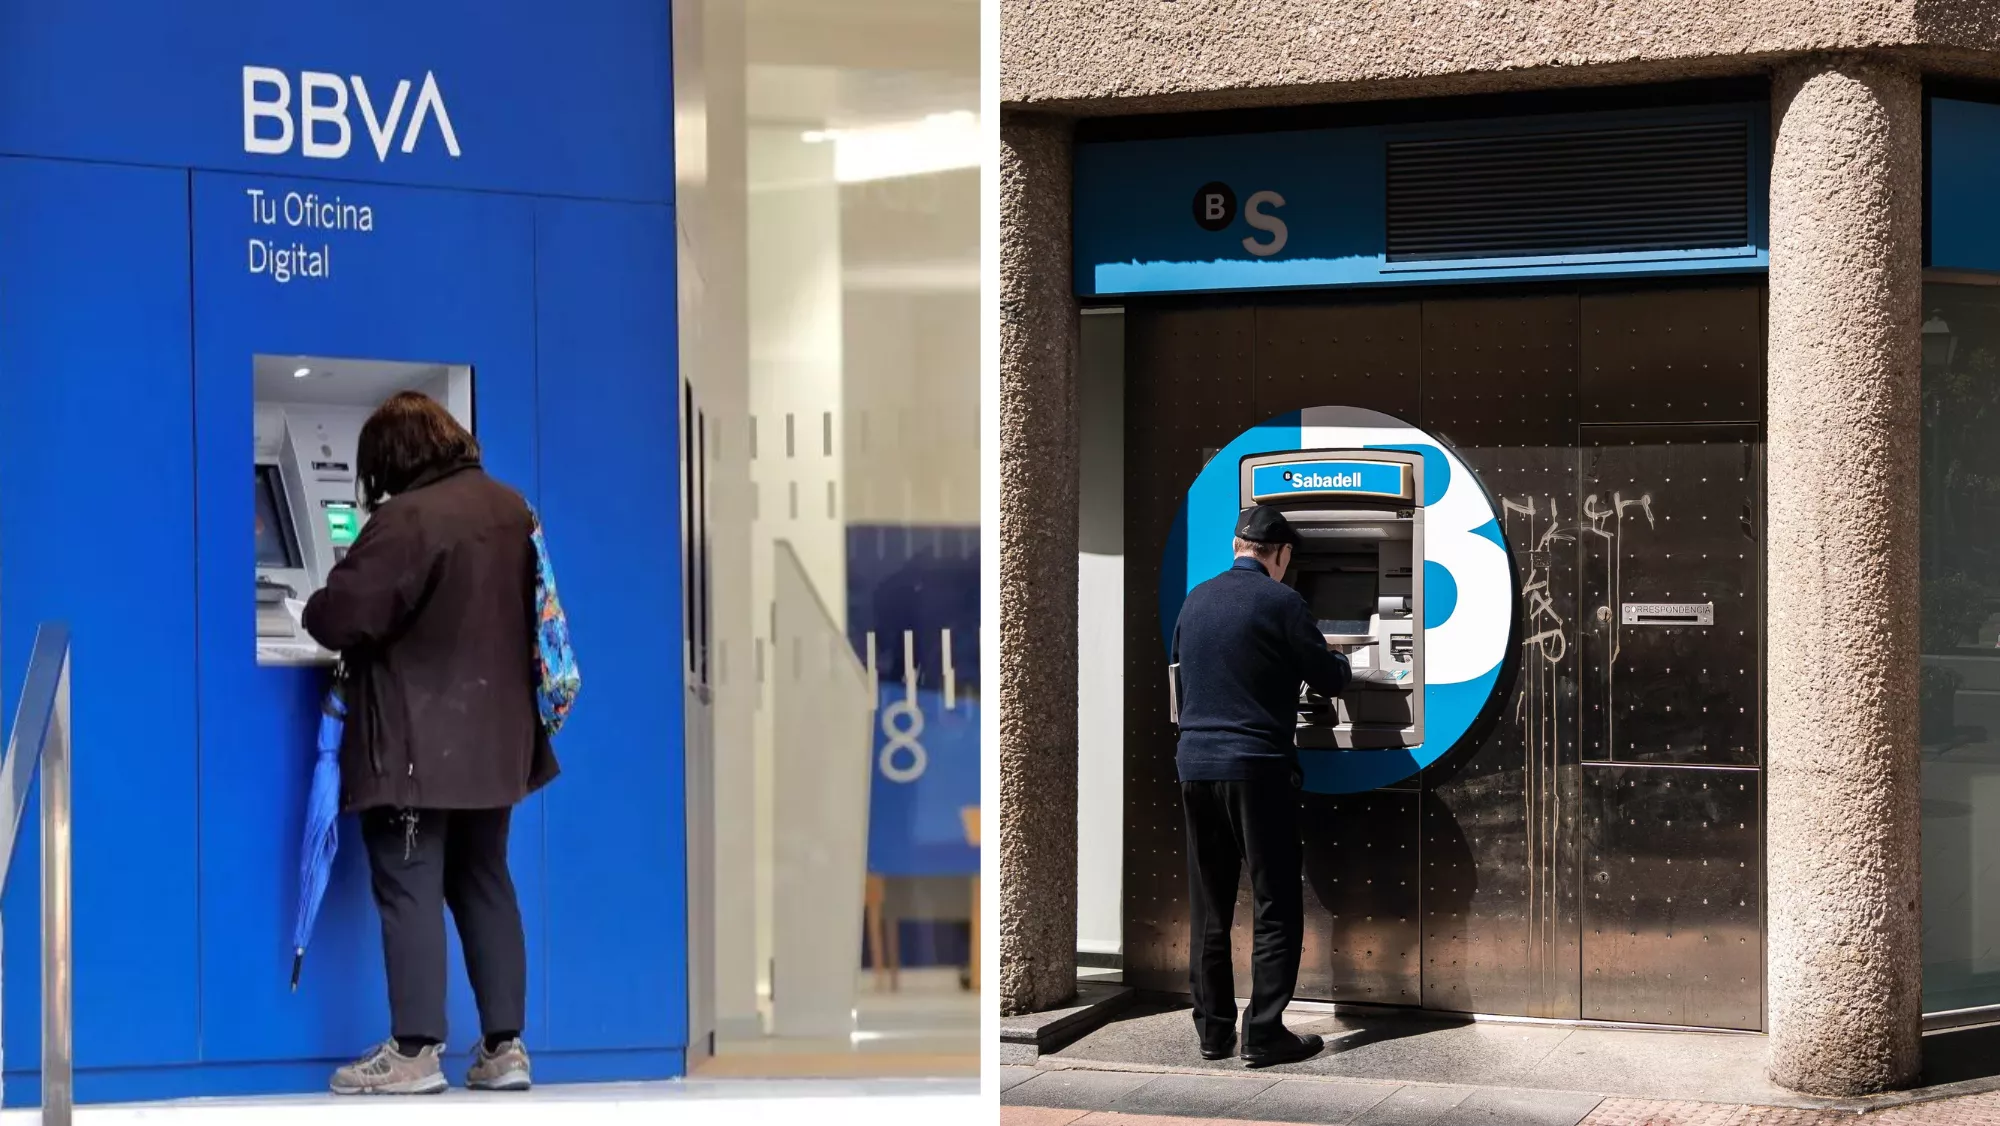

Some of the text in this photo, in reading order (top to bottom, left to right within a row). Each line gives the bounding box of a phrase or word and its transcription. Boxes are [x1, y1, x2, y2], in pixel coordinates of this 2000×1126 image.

[242, 65, 461, 163] BBVA
[247, 189, 373, 232] Tu Oficina
[248, 239, 330, 283] Digital
[1292, 472, 1361, 488] Sabadell
[1624, 605, 1711, 614] CORRESPONDENCIA
[879, 701, 928, 783] 8
